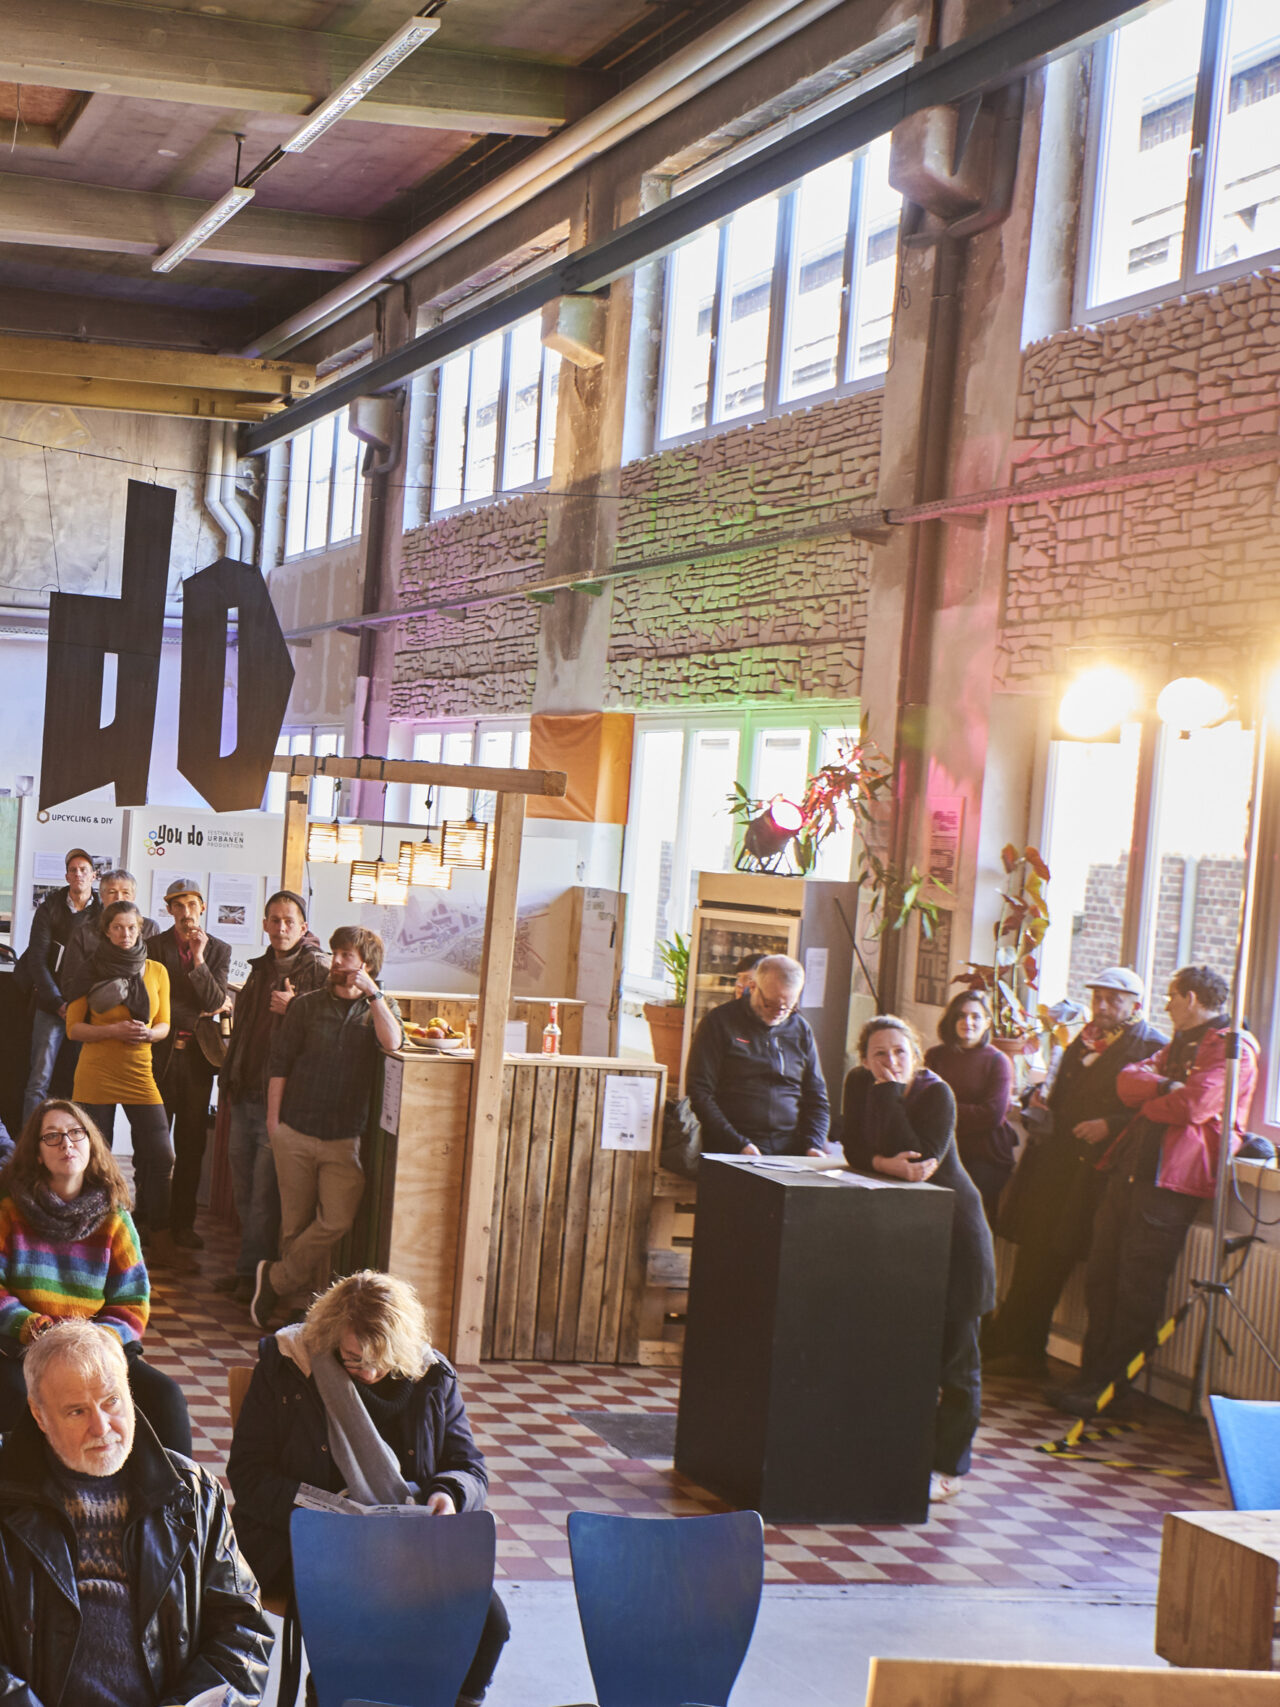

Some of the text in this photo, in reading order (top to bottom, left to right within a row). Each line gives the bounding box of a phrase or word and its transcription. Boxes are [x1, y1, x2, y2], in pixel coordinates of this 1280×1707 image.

[39, 479, 296, 813] do
[51, 814, 92, 823] UPCYCLING
[93, 816, 99, 824] &
[154, 824, 204, 847] you do
[207, 835, 245, 844] URBANEN
